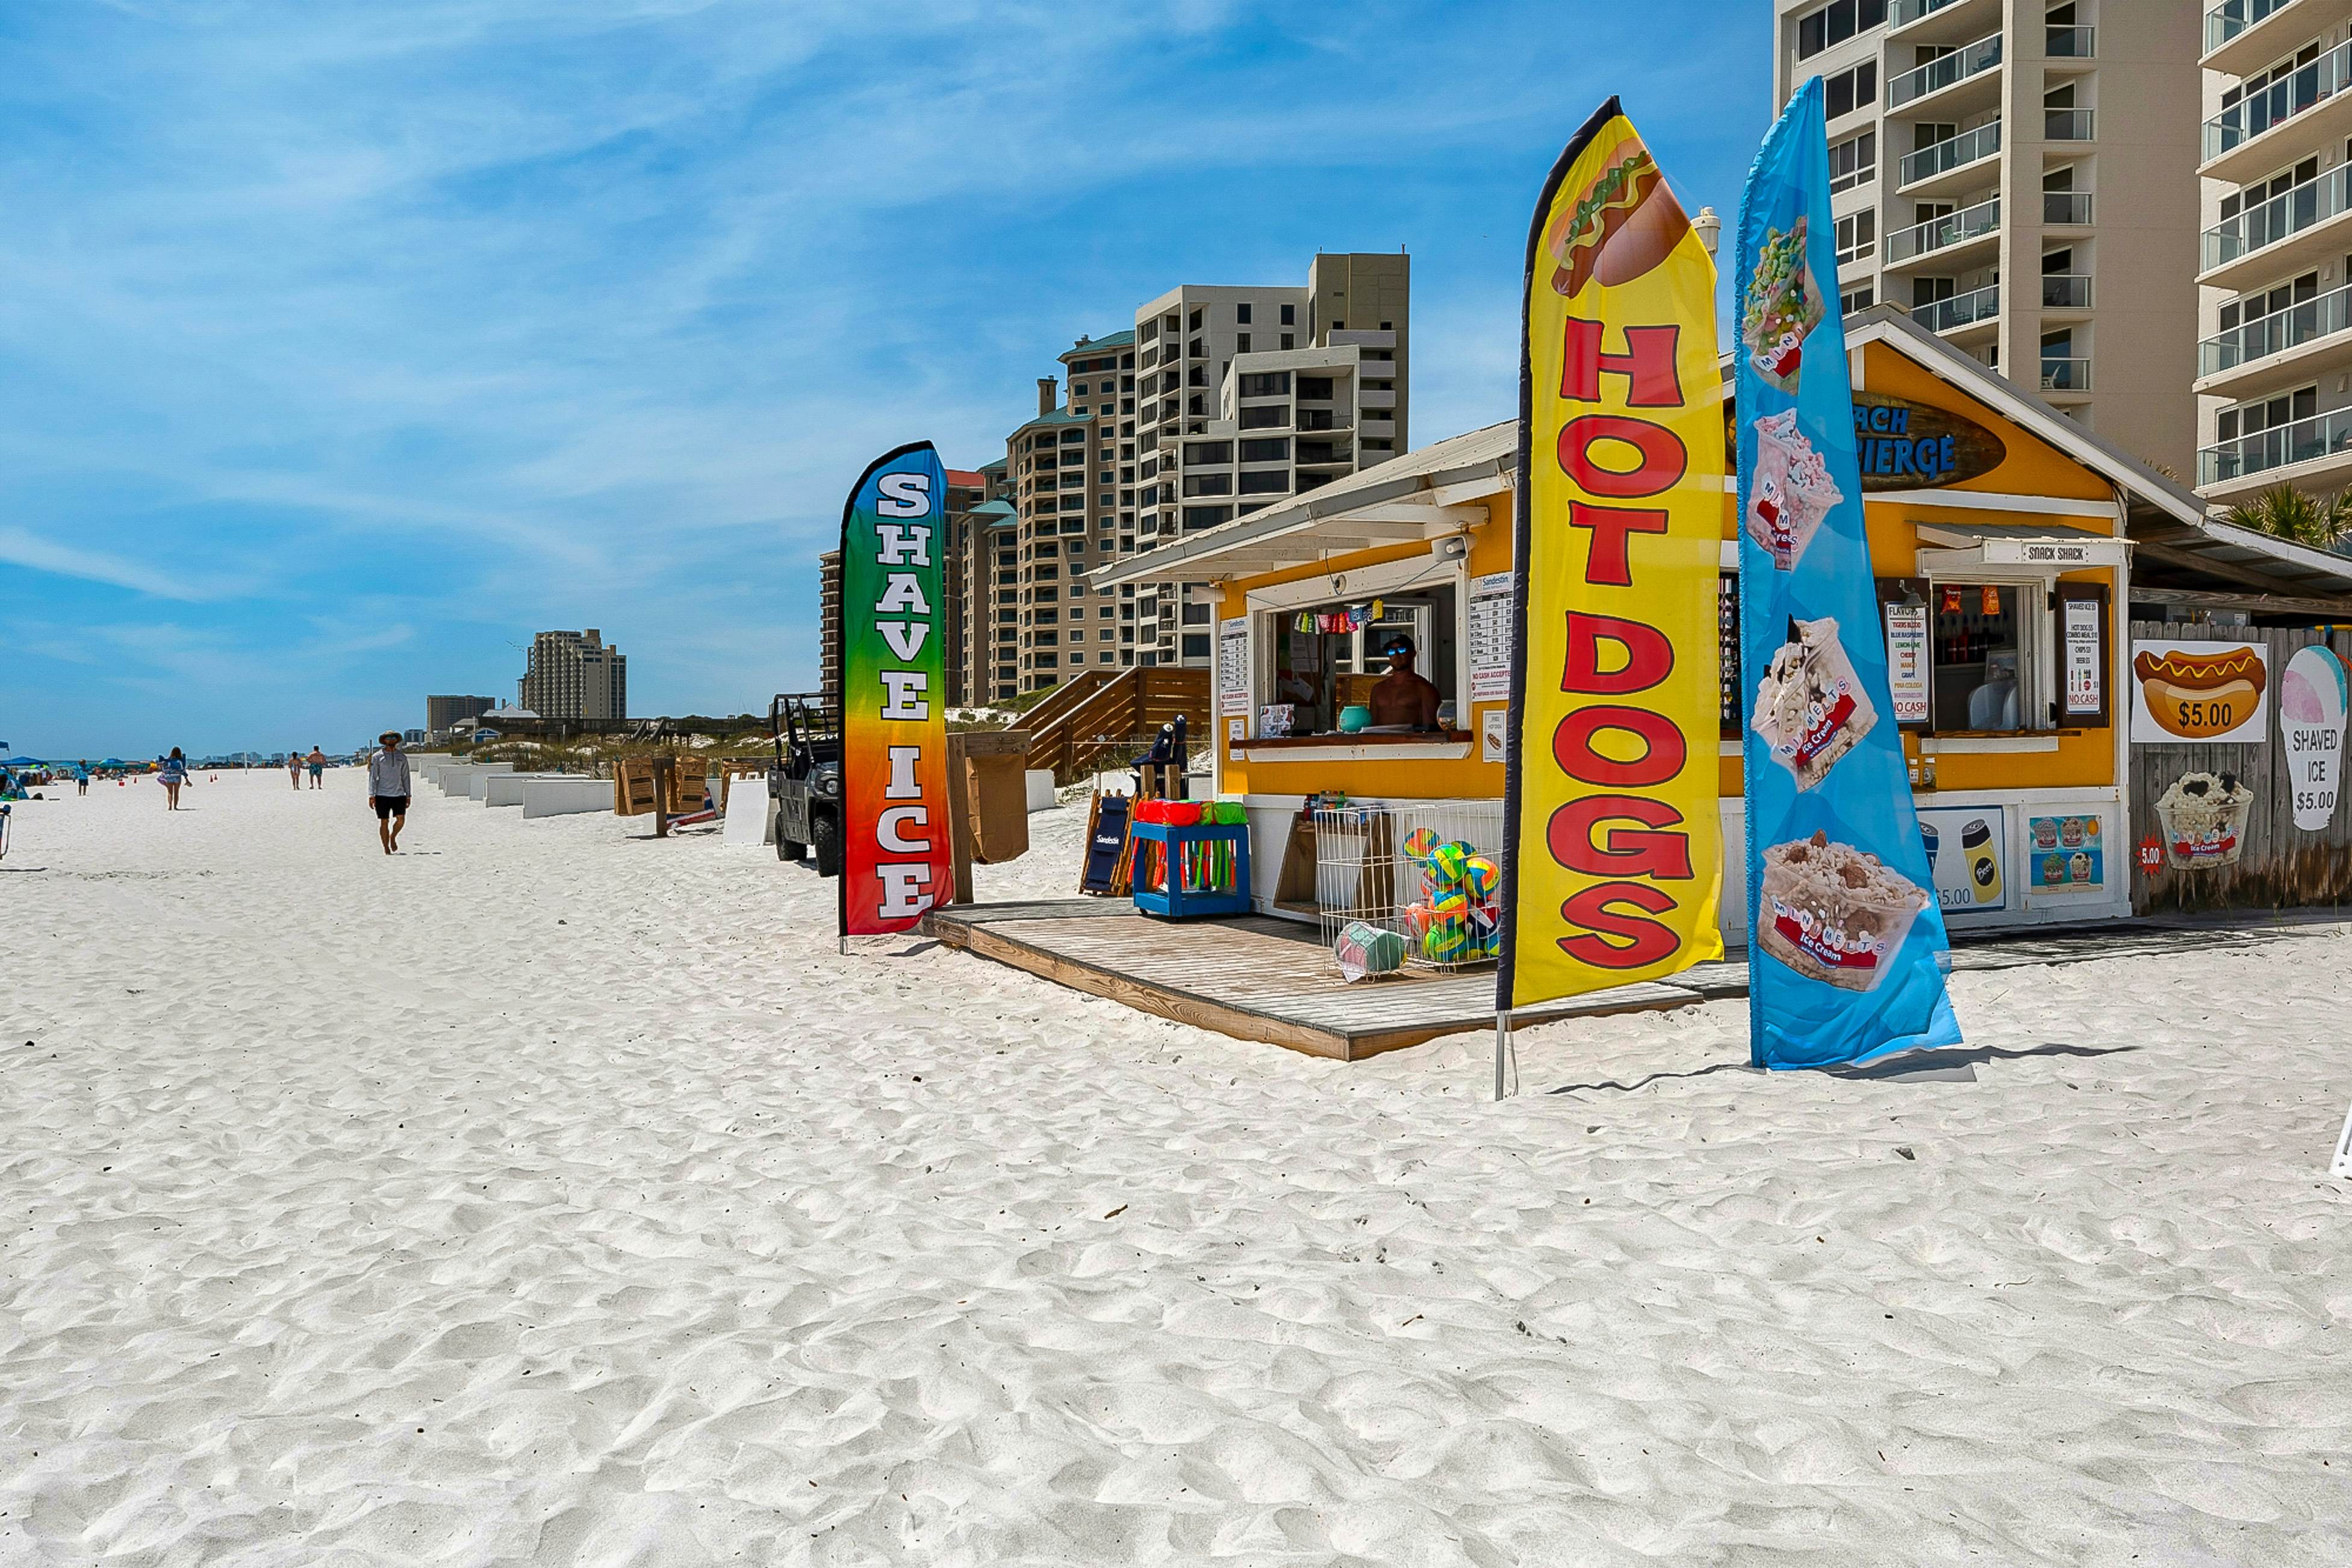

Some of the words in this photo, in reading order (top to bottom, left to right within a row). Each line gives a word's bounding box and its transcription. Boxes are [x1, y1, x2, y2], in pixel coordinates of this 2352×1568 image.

[1853, 405, 1908, 434] ACH
[1557, 316, 1688, 586] HOT
[1856, 434, 1956, 480] IERGE
[2028, 546, 2055, 561] SNACK
[2058, 547, 2083, 561] SHACK
[874, 473, 932, 721] SHAVE
[1905, 702, 1927, 712] CASH
[2068, 694, 2080, 703] NO
[2080, 694, 2098, 703] CASH
[2178, 700, 2232, 729] $5.00
[2293, 729, 2337, 752] SHAVED
[2308, 761, 2326, 783] ICE
[1546, 611, 1694, 969] DOGS
[2297, 791, 2334, 812] $5.00
[876, 745, 933, 919] ICE
[2142, 847, 2160, 864] 5.00
[1976, 862, 1993, 880] Beer
[1775, 903, 1819, 934] MINI
[1825, 930, 1885, 953] MELTS
[1800, 932, 1814, 948] Ice
[1815, 942, 1841, 962] Cream
